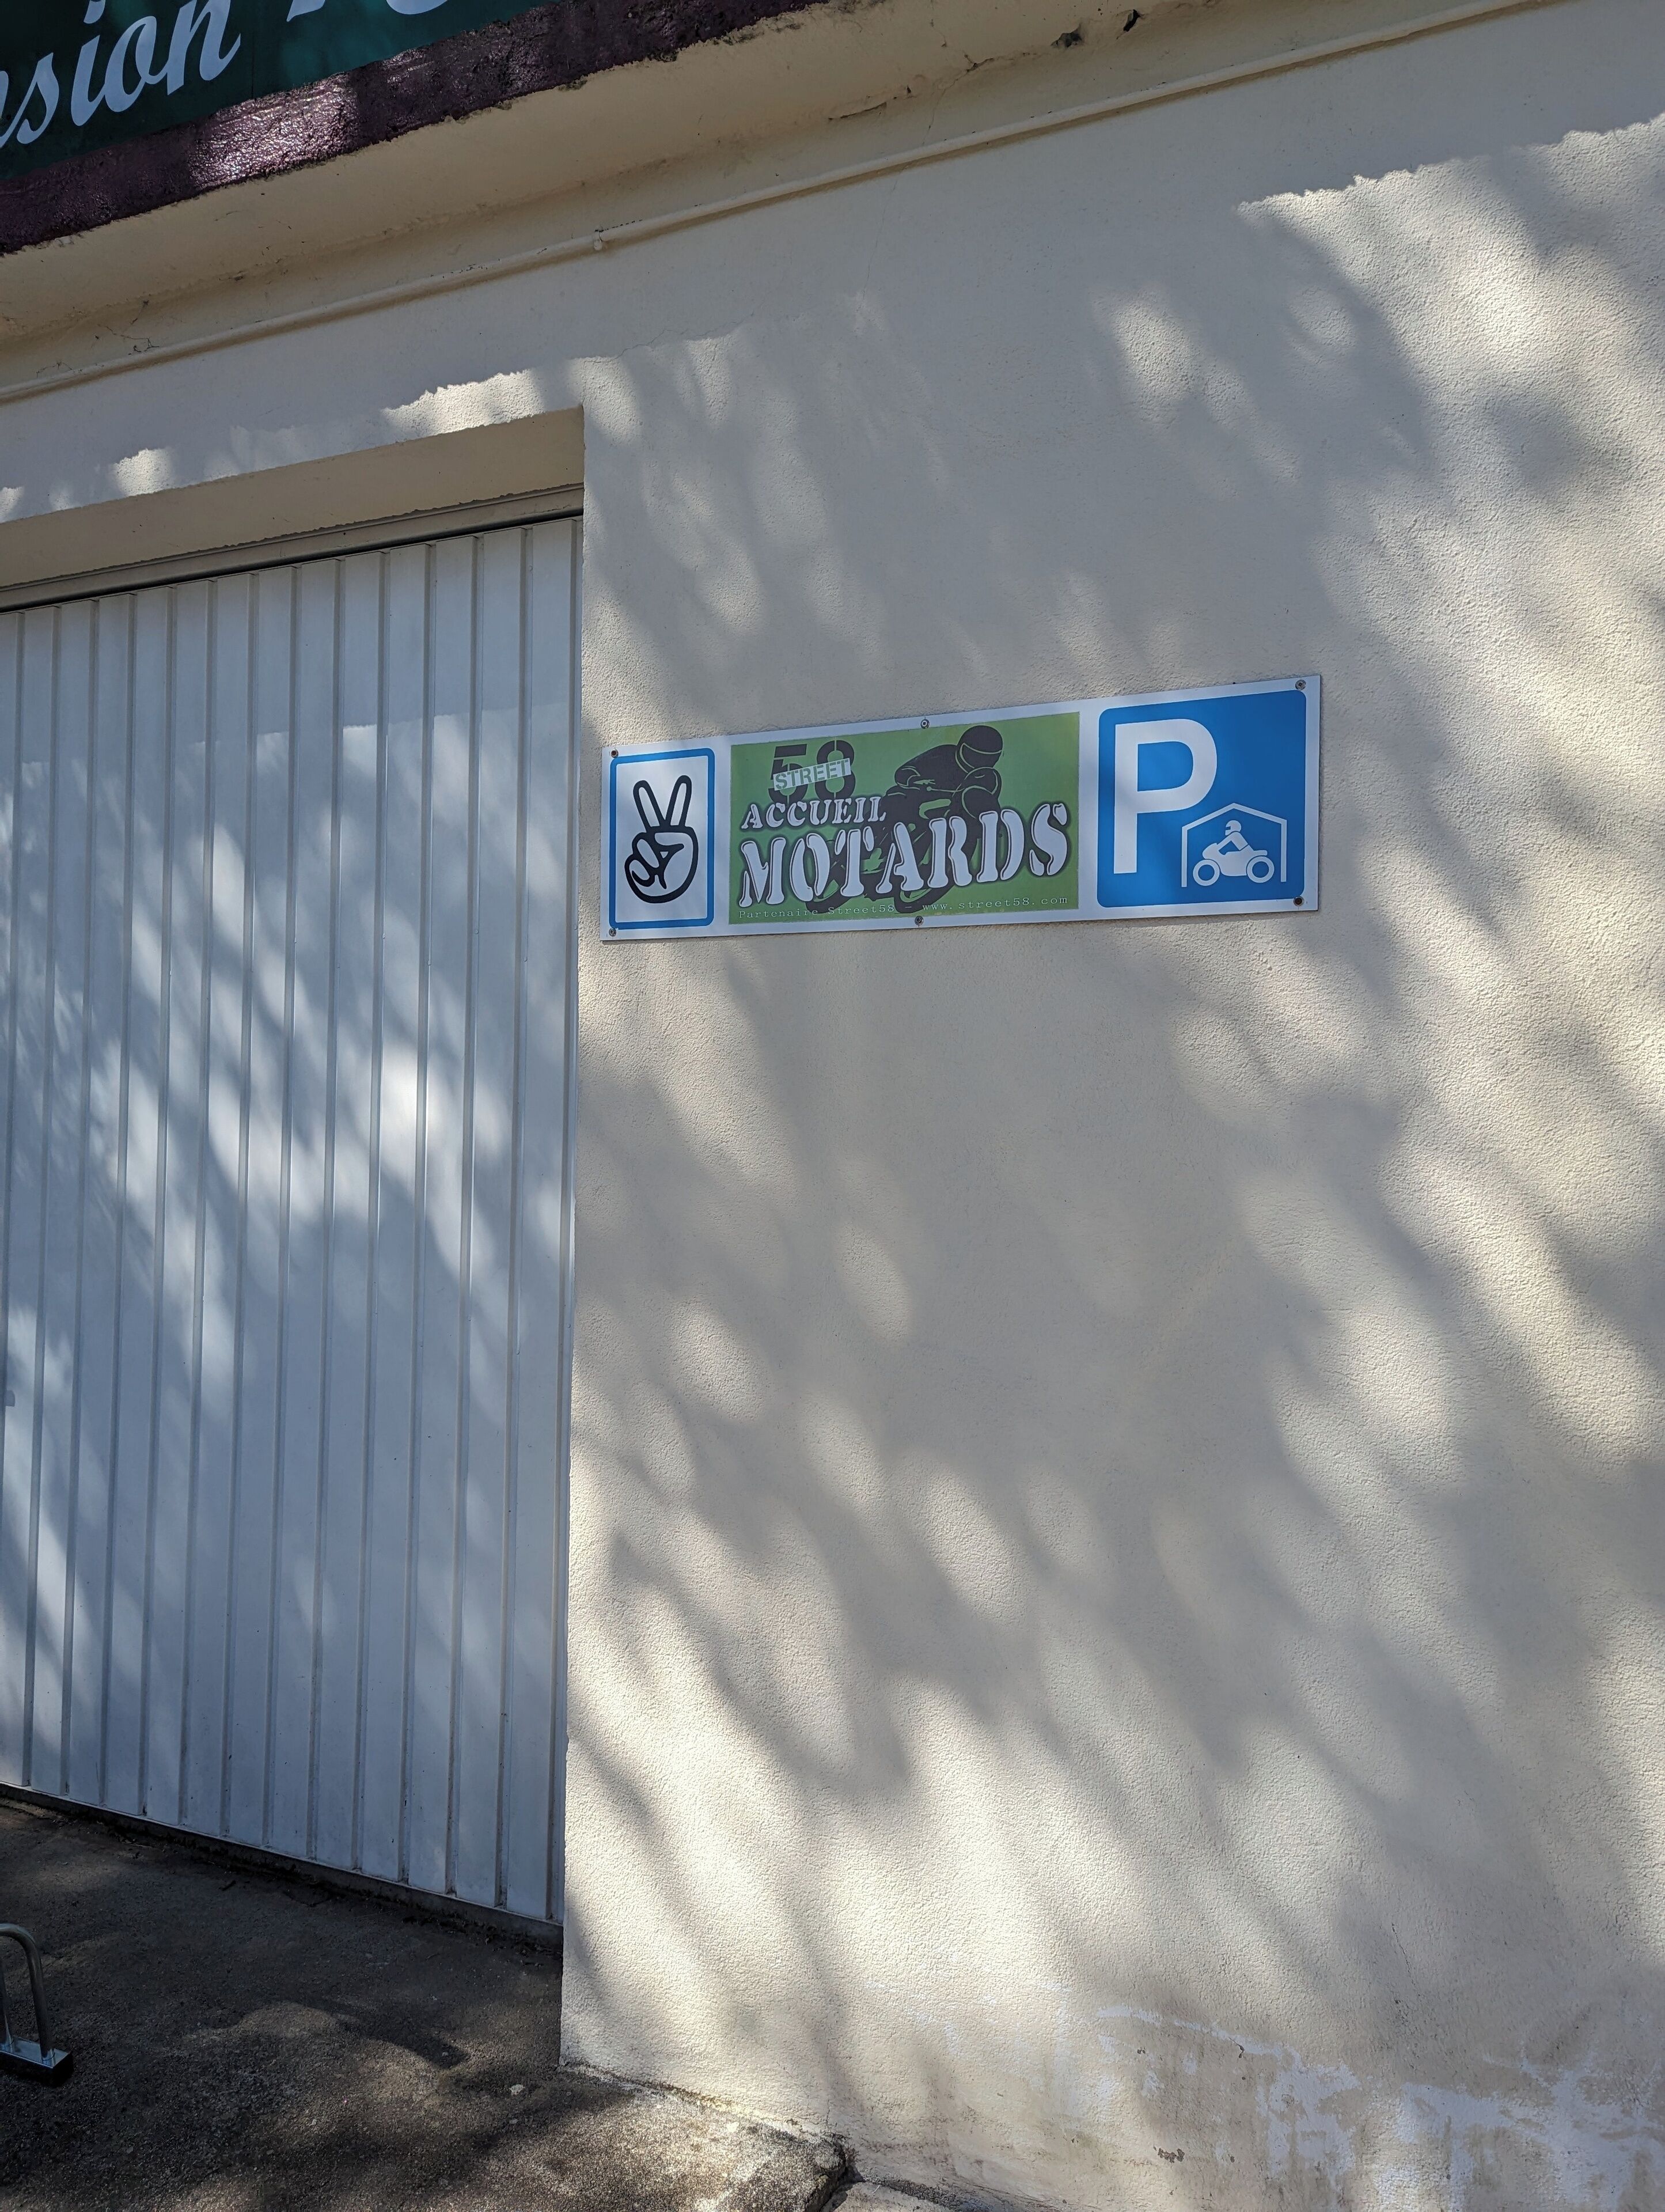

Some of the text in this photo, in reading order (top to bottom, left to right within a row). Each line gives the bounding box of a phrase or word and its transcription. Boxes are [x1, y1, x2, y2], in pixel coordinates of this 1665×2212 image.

[768, 740, 856, 805] 58
[775, 759, 849, 789] STREET
[1114, 718, 1218, 874] P
[741, 796, 887, 830] ACCUEIL
[738, 802, 1069, 908] MOTARDS
[739, 908, 818, 918] Partenaire
[828, 904, 895, 915] Street58
